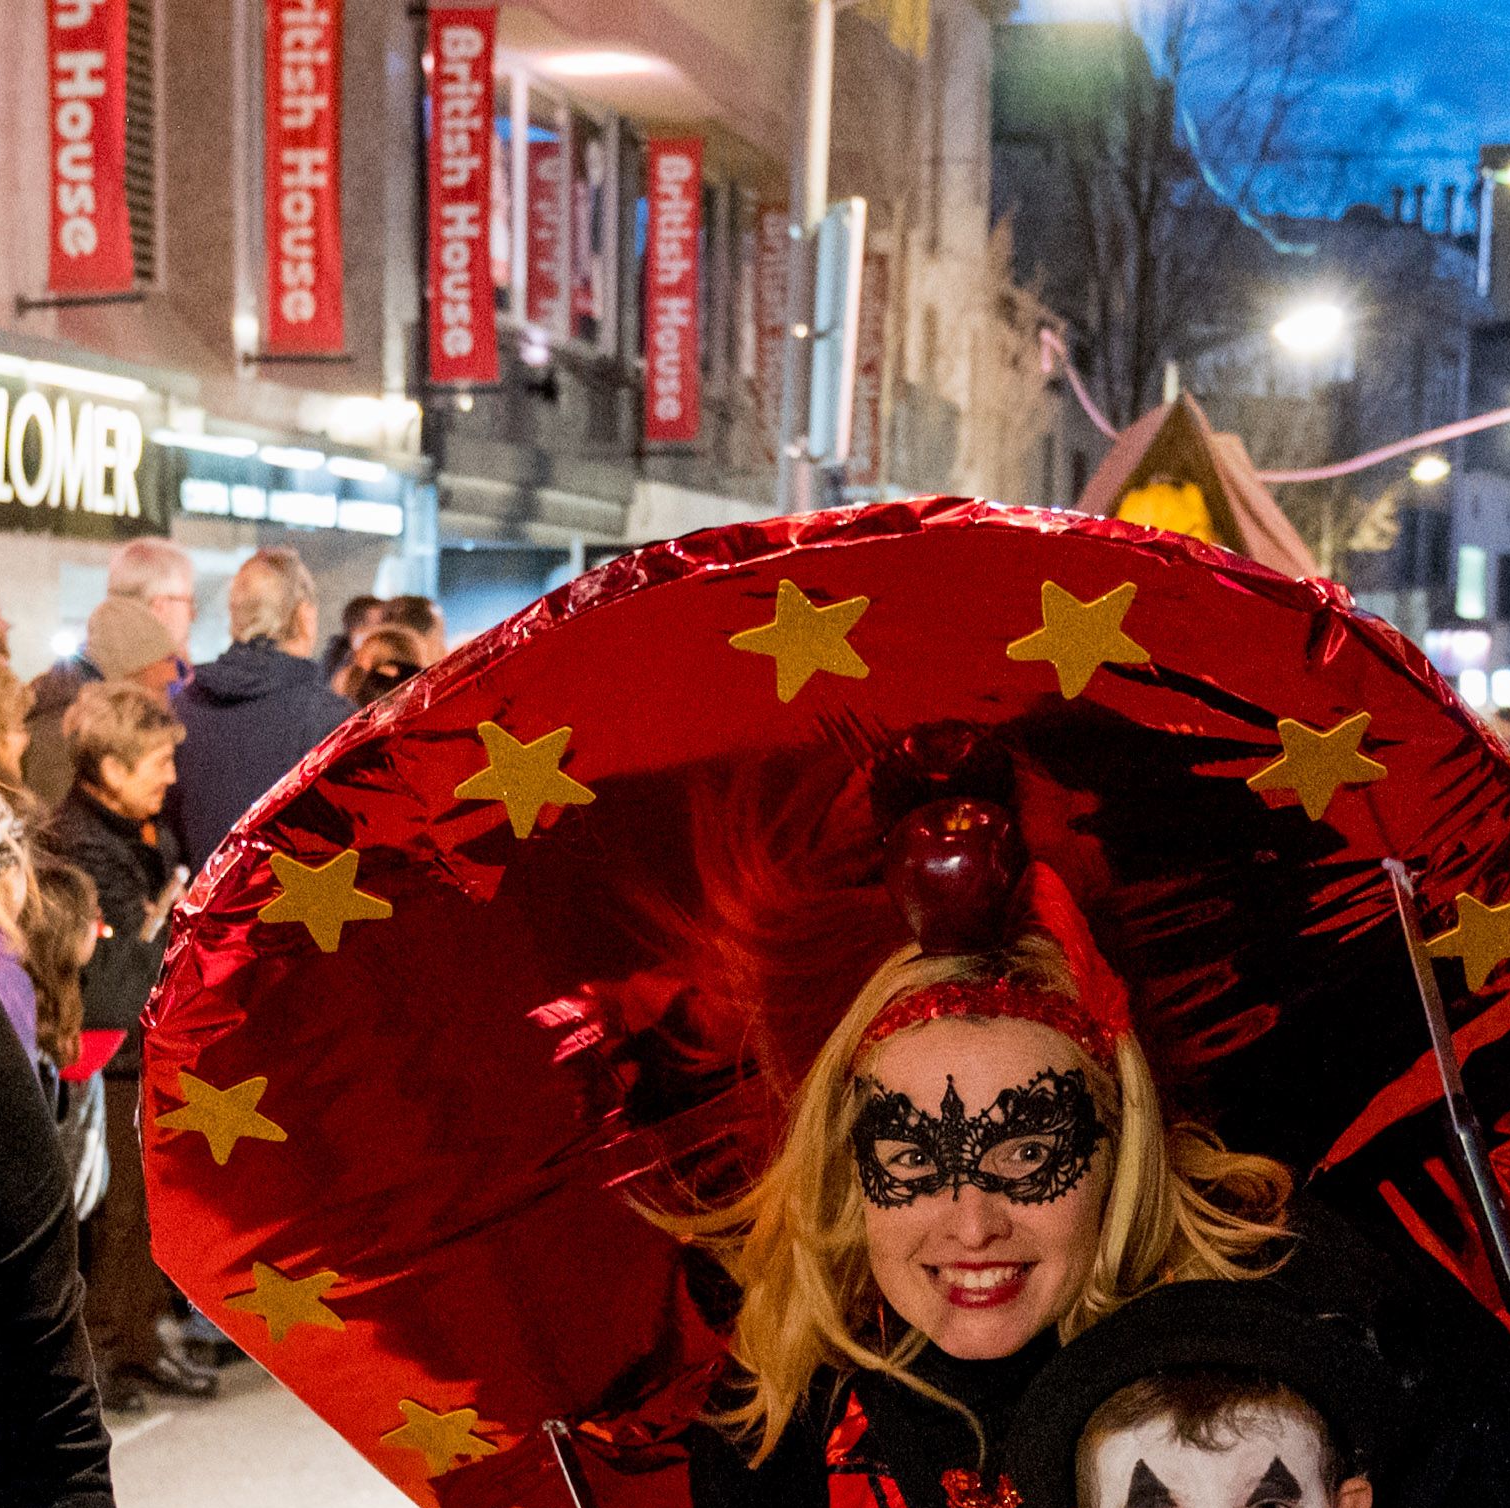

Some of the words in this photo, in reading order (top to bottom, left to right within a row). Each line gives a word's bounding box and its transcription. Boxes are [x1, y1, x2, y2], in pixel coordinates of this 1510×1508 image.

[281, 0, 329, 129] itish
[440, 26, 484, 188] British
[56, 52, 106, 258] House
[656, 155, 693, 285] British
[281, 150, 329, 323] House
[441, 204, 480, 357] House
[655, 298, 689, 421] House
